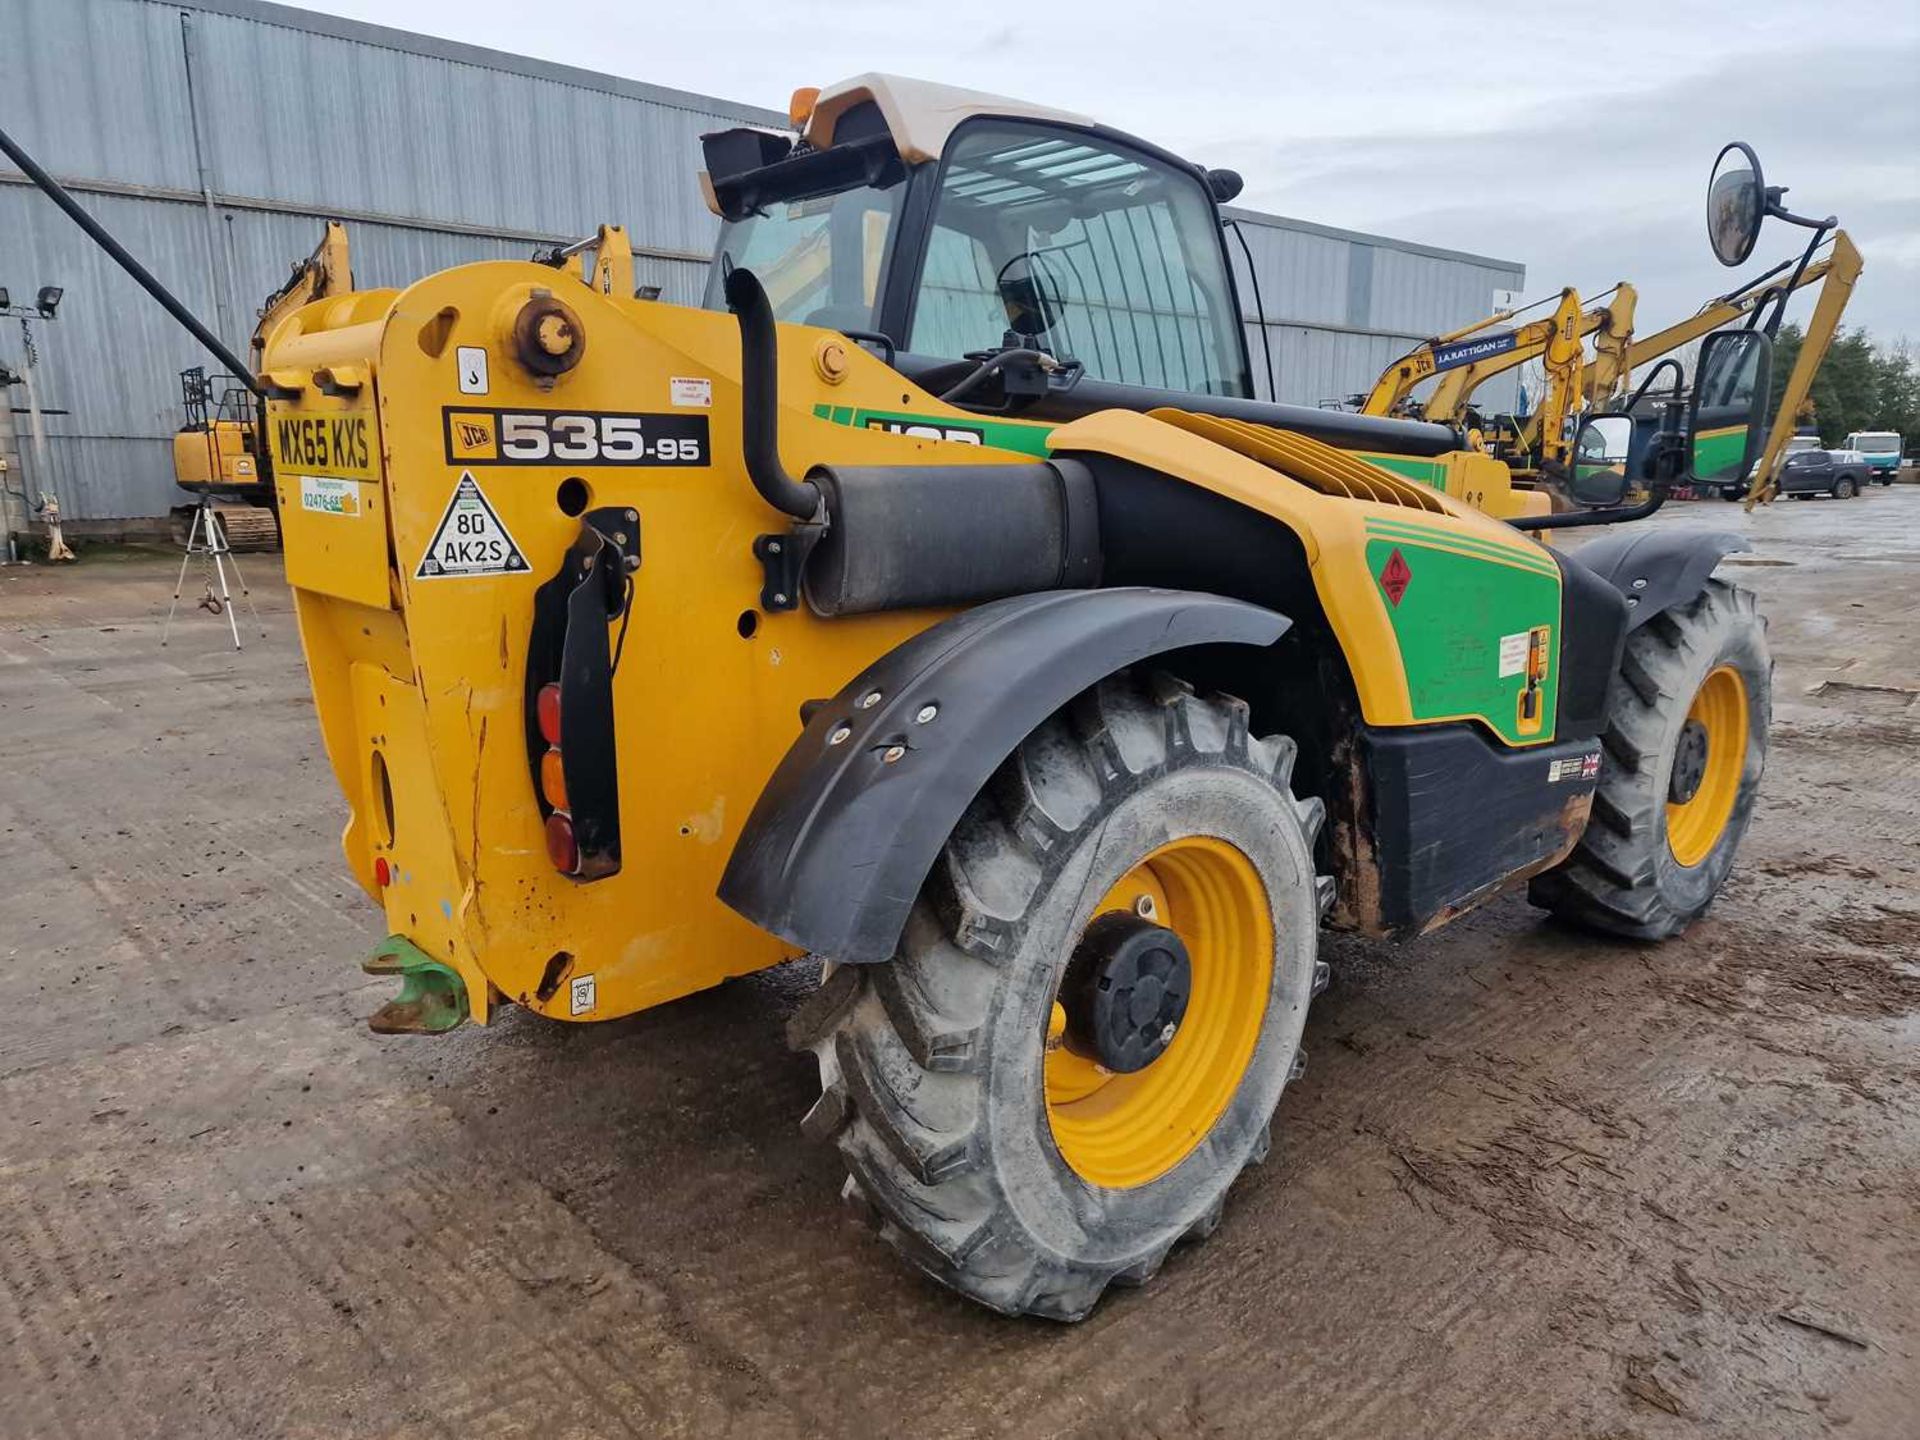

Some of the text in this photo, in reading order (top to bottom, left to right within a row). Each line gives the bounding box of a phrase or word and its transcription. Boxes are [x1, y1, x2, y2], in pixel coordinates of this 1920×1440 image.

[278, 418, 369, 468] MX65 KXS
[463, 414, 700, 461] JCB 535-95
[457, 513, 485, 534] 80
[444, 540, 503, 564] AK2S
